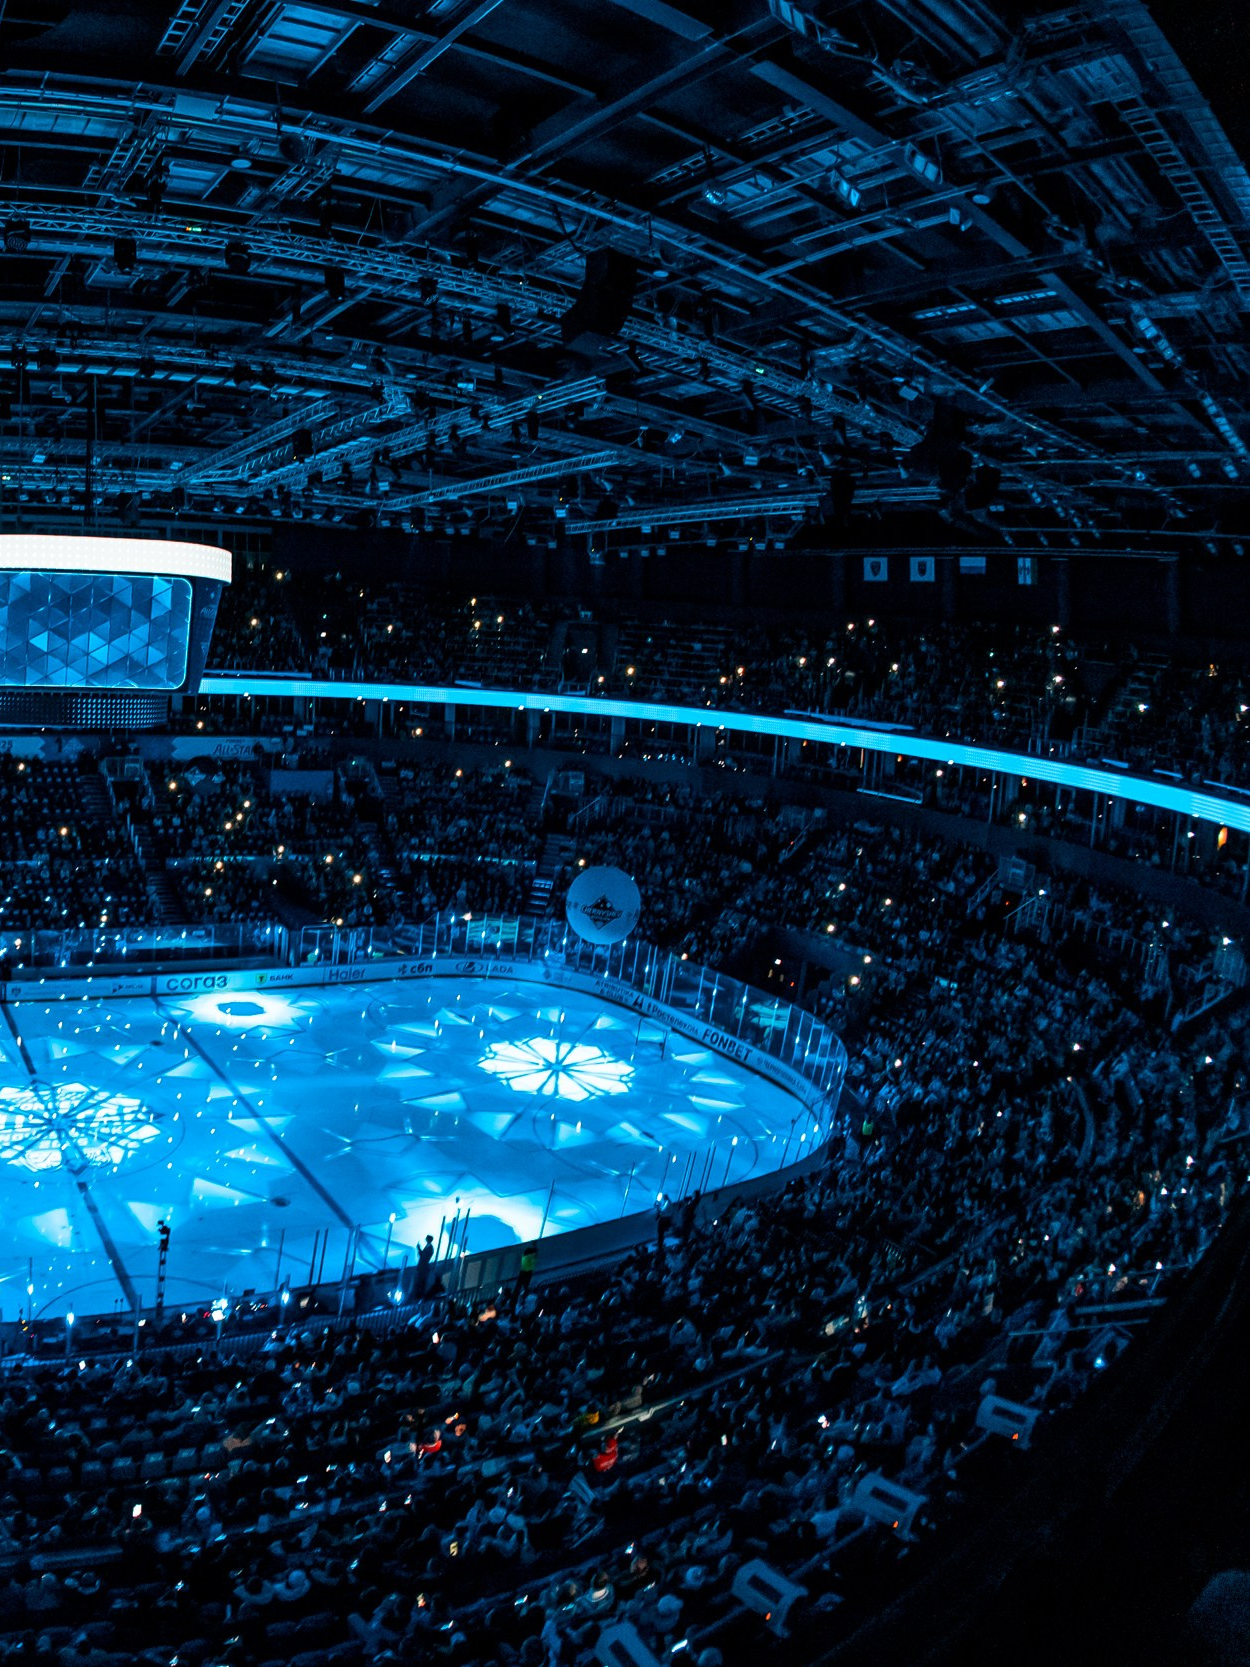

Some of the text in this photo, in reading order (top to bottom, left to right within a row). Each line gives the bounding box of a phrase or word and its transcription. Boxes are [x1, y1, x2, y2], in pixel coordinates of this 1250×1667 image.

[328, 968, 366, 981] Haier
[410, 962, 433, 975] сбп
[486, 964, 514, 974] LADA
[269, 974, 294, 982] БАНК
[702, 1028, 753, 1062] FONBET
